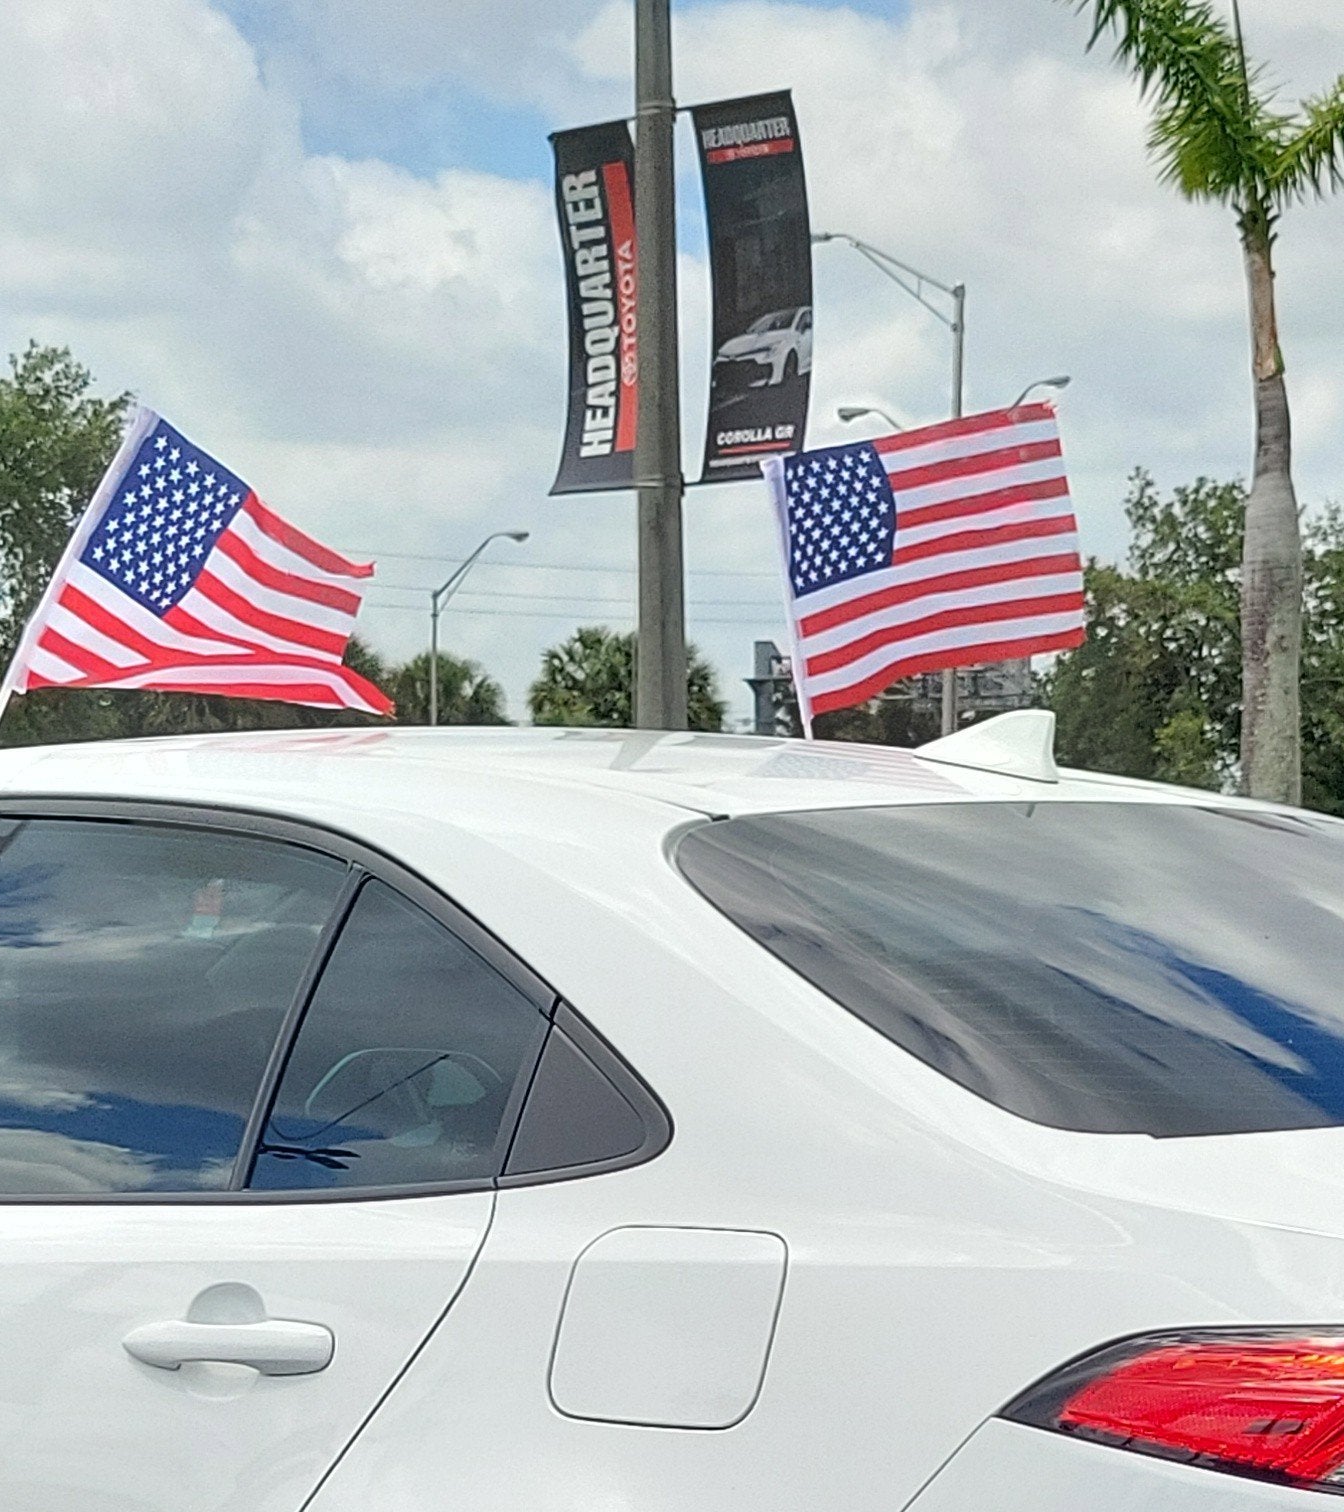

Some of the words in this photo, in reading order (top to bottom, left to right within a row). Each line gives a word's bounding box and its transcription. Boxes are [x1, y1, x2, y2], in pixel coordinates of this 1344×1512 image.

[563, 169, 619, 460] HEADQUARTER
[618, 239, 637, 351] TOYOTA
[717, 427, 773, 445] COROLLA
